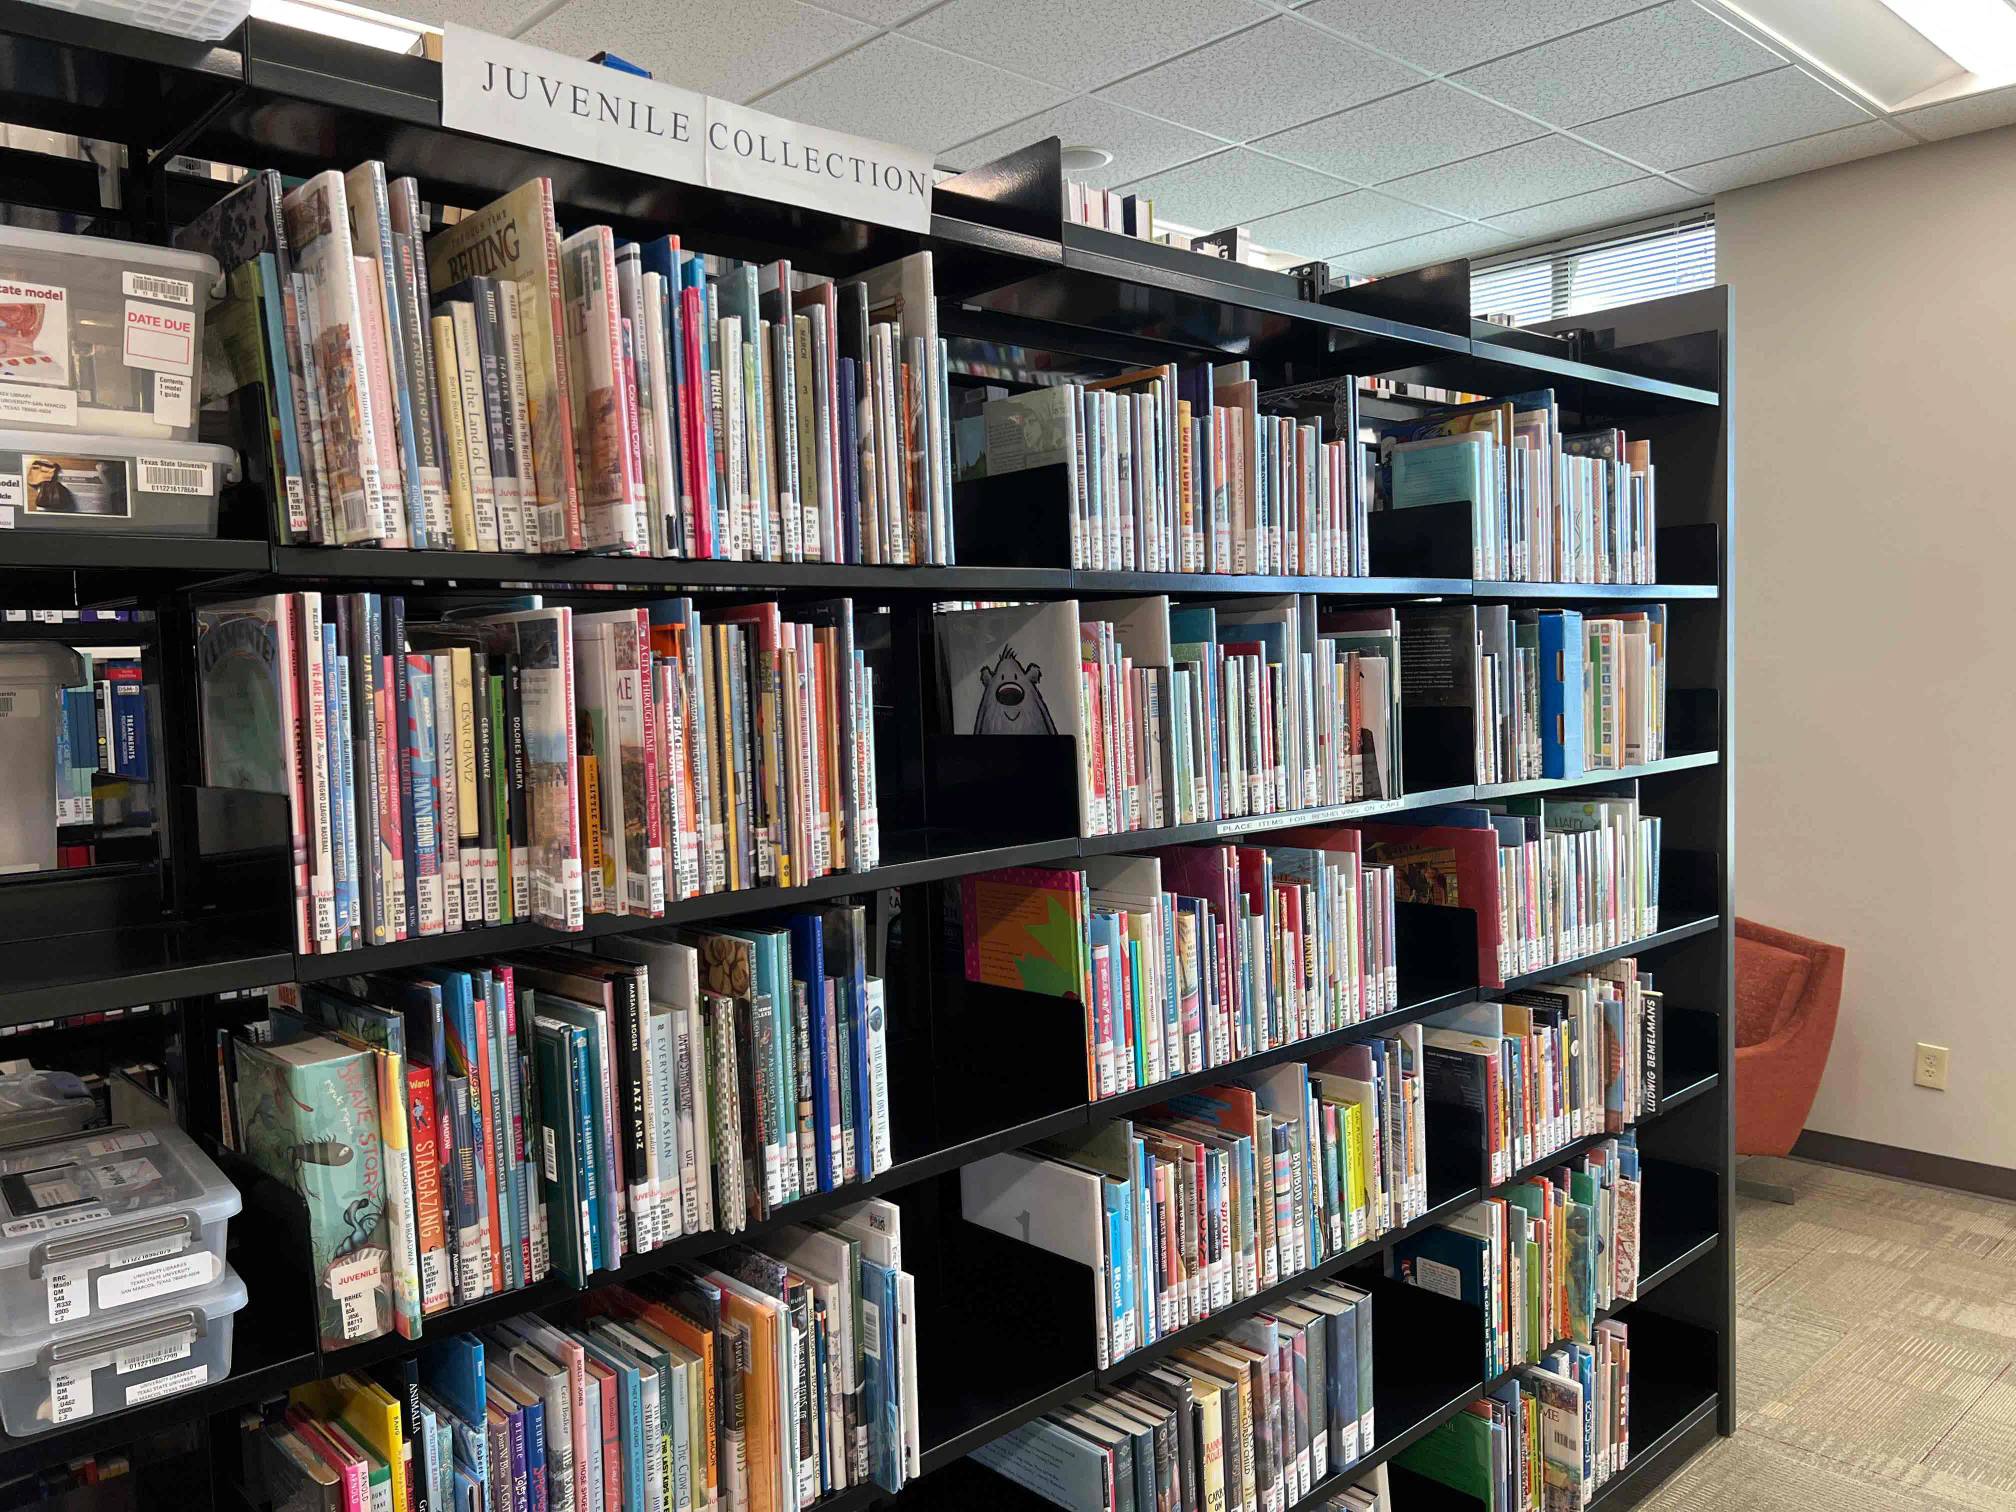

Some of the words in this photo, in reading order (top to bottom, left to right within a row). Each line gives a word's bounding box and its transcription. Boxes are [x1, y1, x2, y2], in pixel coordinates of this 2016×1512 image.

[481, 61, 691, 144] JUVENILE
[708, 121, 927, 199] COLLECTION
[275, 195, 288, 249] Wisniewski
[448, 217, 521, 284] BEIJING
[25, 289, 63, 301] model
[550, 267, 560, 299] TIME
[128, 312, 161, 327] DATE
[165, 319, 191, 332] DUE
[410, 318, 421, 339] LIFE
[415, 369, 426, 406] DEATH
[464, 369, 475, 378] In
[710, 369, 722, 409] TWELVE
[465, 382, 477, 407] the
[485, 354, 502, 451] MOTHER
[420, 408, 429, 421] OF
[469, 412, 480, 441] Land
[140, 458, 159, 467] Texas
[177, 461, 208, 470] University
[473, 448, 485, 462] of
[312, 663, 321, 678] WE
[363, 654, 373, 704] DANZA!
[641, 653, 650, 676] CITY
[312, 680, 322, 697] ARE
[642, 679, 652, 727] THROUGH
[314, 699, 323, 716] THE
[461, 702, 472, 735] CÉSAR
[127, 715, 135, 760] TREATMENTS
[315, 719, 324, 741] SHIP
[481, 717, 489, 745] CESAR
[513, 716, 521, 755] DOLORES
[645, 730, 654, 754] TIME
[376, 749, 385, 770] Born
[445, 758, 455, 787] DAYS
[463, 739, 473, 784] CHÁVEZ
[482, 746, 490, 779] CHAVEZ
[515, 757, 523, 789] HUERTA
[1095, 750, 1104, 786] perfect
[319, 780, 328, 801] NEGRO
[379, 774, 386, 784] to
[320, 802, 328, 825] LEAGUE
[379, 786, 388, 815] Dance
[414, 784, 432, 816] MAN
[417, 816, 434, 847] BEHIND
[1223, 823, 1252, 832] PLACE
[1311, 808, 1359, 820] RESHELVING
[1380, 801, 1400, 809] CART
[321, 826, 329, 854] BASEBALL
[1304, 934, 1313, 977] KONRAD
[752, 1005, 760, 1038] NELSON
[1646, 999, 1656, 1067] BEMELMANS
[873, 1045, 882, 1061] THE
[409, 1078, 431, 1091] Wang
[657, 1037, 670, 1116] EVERYTHING
[875, 1063, 884, 1080] ONE
[633, 1079, 642, 1112] JAZZ
[875, 1082, 884, 1098] AND
[1647, 1071, 1656, 1112] LUDWIG
[492, 1092, 502, 1125] JORGE
[876, 1099, 885, 1120] ONLY
[495, 1128, 503, 1150] LUIS
[514, 1122, 524, 1155] PABLO
[662, 1121, 672, 1159] ASIAN
[358, 1132, 380, 1201] STORY
[400, 1152, 410, 1197] BALLOONS
[496, 1151, 507, 1192] BORGES
[685, 1150, 693, 1168] LUTZ
[1263, 1156, 1272, 1175] OUT
[415, 1140, 441, 1237] STARGAZING
[1264, 1180, 1272, 1193] OF
[1292, 1152, 1303, 1201] BAMBOO
[403, 1198, 412, 1221] OVER
[442, 1115, 451, 1150] SHADOW
[452, 1253, 460, 1287] Atheneum
[1220, 1201, 1229, 1249] sprout
[404, 1223, 415, 1267] BROADWAY
[52, 1274, 66, 1283] RRC
[53, 1280, 72, 1289] Model
[338, 1267, 378, 1285] JUVENILE
[1112, 1266, 1121, 1309] BROWN
[424, 1292, 450, 1306] Juven
[408, 1383, 422, 1434] ANIMALIA
[644, 1403, 653, 1440] STRIPED
[708, 1386, 716, 1438] GOODNIGHT
[495, 1431, 508, 1448] Joan
[514, 1421, 524, 1459] Blume
[535, 1416, 545, 1454] Blume
[677, 1440, 688, 1461] The
[476, 1443, 485, 1475] Robert
[562, 1444, 572, 1468] THE
[646, 1443, 655, 1482] PAJAMAS
[709, 1439, 717, 1467] MOON
[1243, 1450, 1251, 1475] CHILD
[350, 1472, 360, 1504] ARNOLD
[360, 1471, 369, 1502] ARNOLD
[501, 1484, 511, 1493] A
[513, 1471, 527, 1496] Tales
